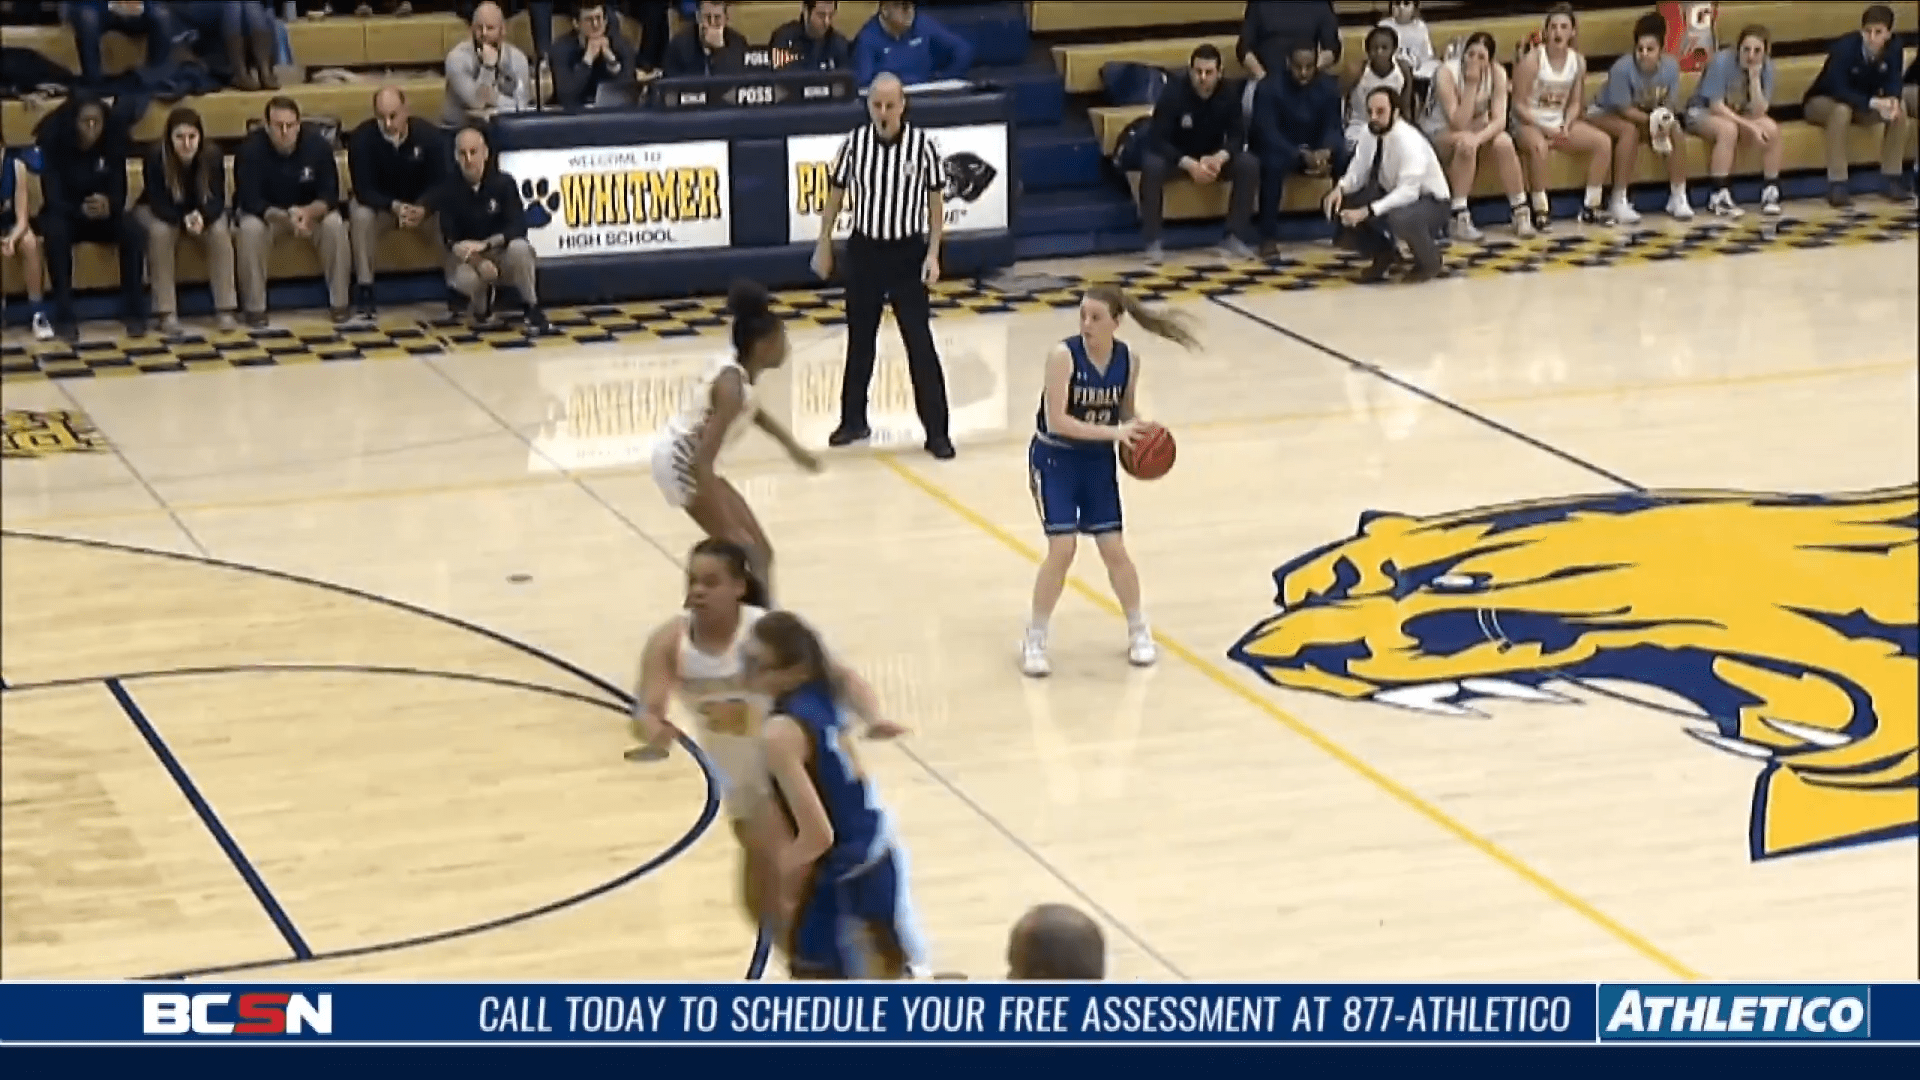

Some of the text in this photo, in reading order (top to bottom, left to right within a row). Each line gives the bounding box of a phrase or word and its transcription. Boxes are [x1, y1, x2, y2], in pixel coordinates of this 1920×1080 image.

[737, 86, 773, 105] POSS
[560, 167, 721, 229] WHITMER
[558, 229, 676, 249] HIGH SCHOOL
